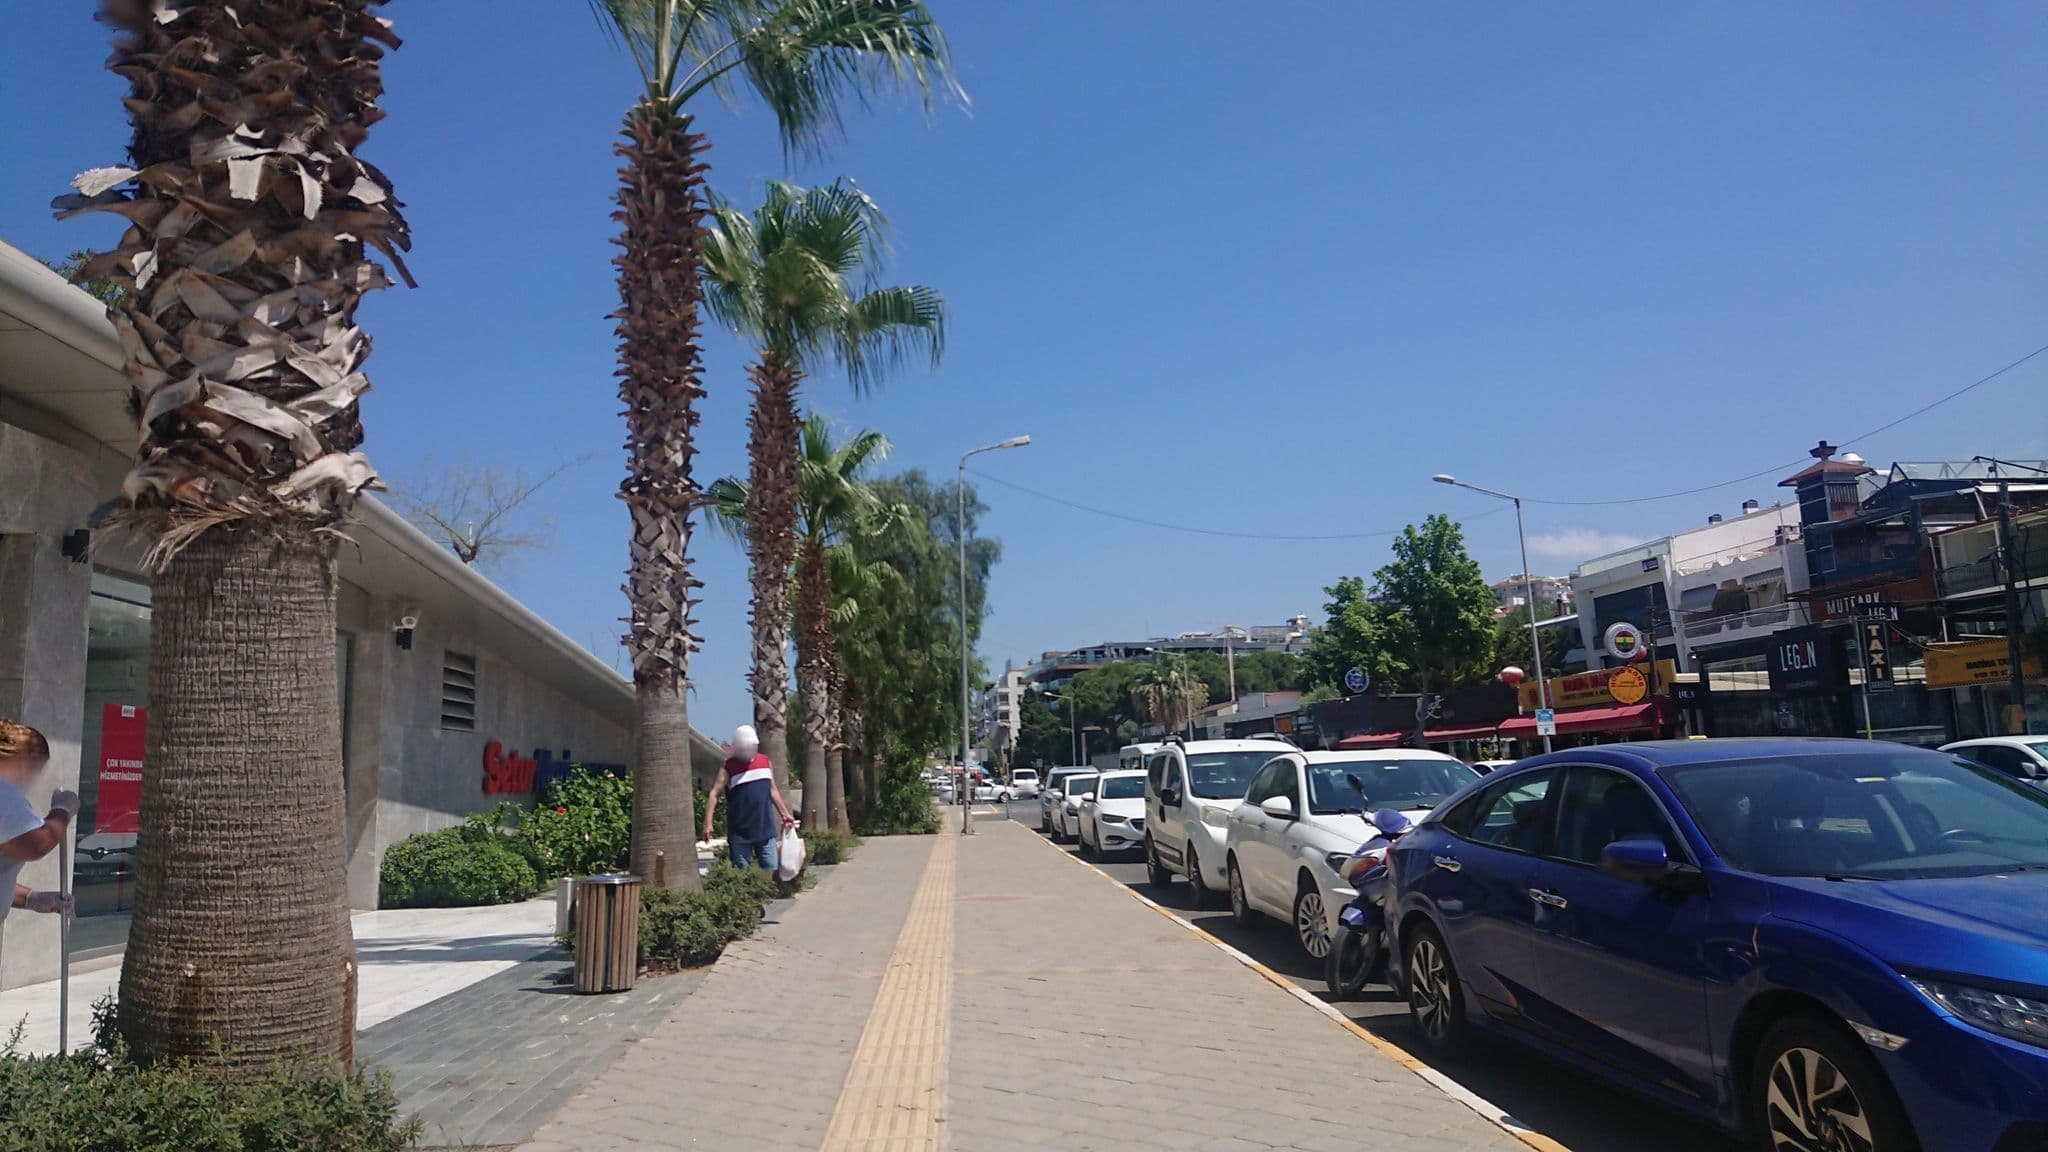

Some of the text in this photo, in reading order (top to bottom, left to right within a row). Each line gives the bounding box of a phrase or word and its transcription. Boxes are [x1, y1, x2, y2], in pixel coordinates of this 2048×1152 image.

[1779, 640, 1816, 671] LEGON
[1866, 624, 1887, 679] TAXI
[1628, 668, 1644, 687] KONG
